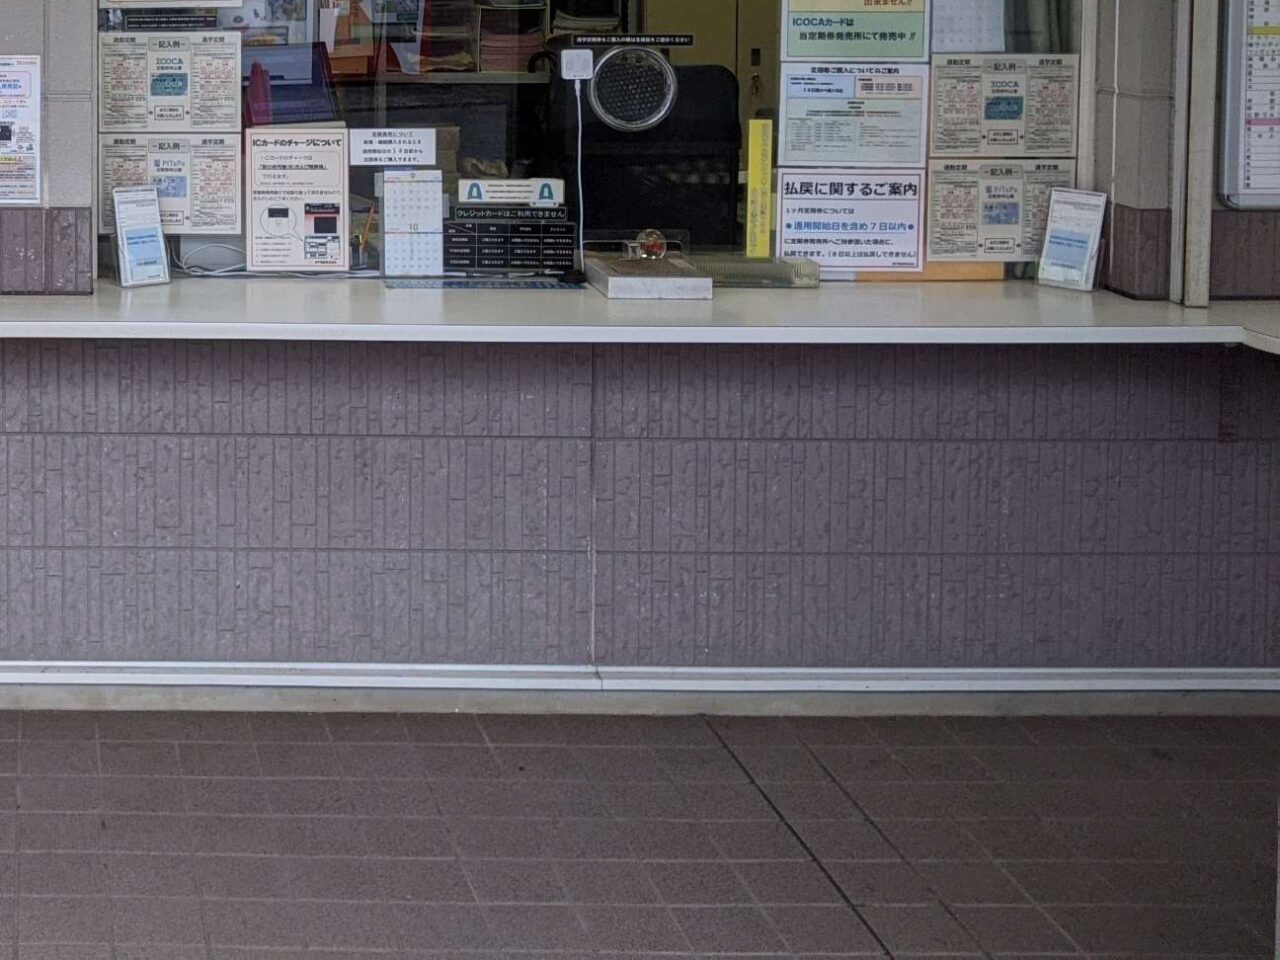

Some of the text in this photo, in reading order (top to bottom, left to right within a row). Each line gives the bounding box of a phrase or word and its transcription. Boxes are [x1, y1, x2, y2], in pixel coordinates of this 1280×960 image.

[793, 18, 854, 27] ICOCAカードは
[253, 139, 342, 147] ICカードのチャージについて
[784, 182, 918, 196] 払戻に関するご案内
